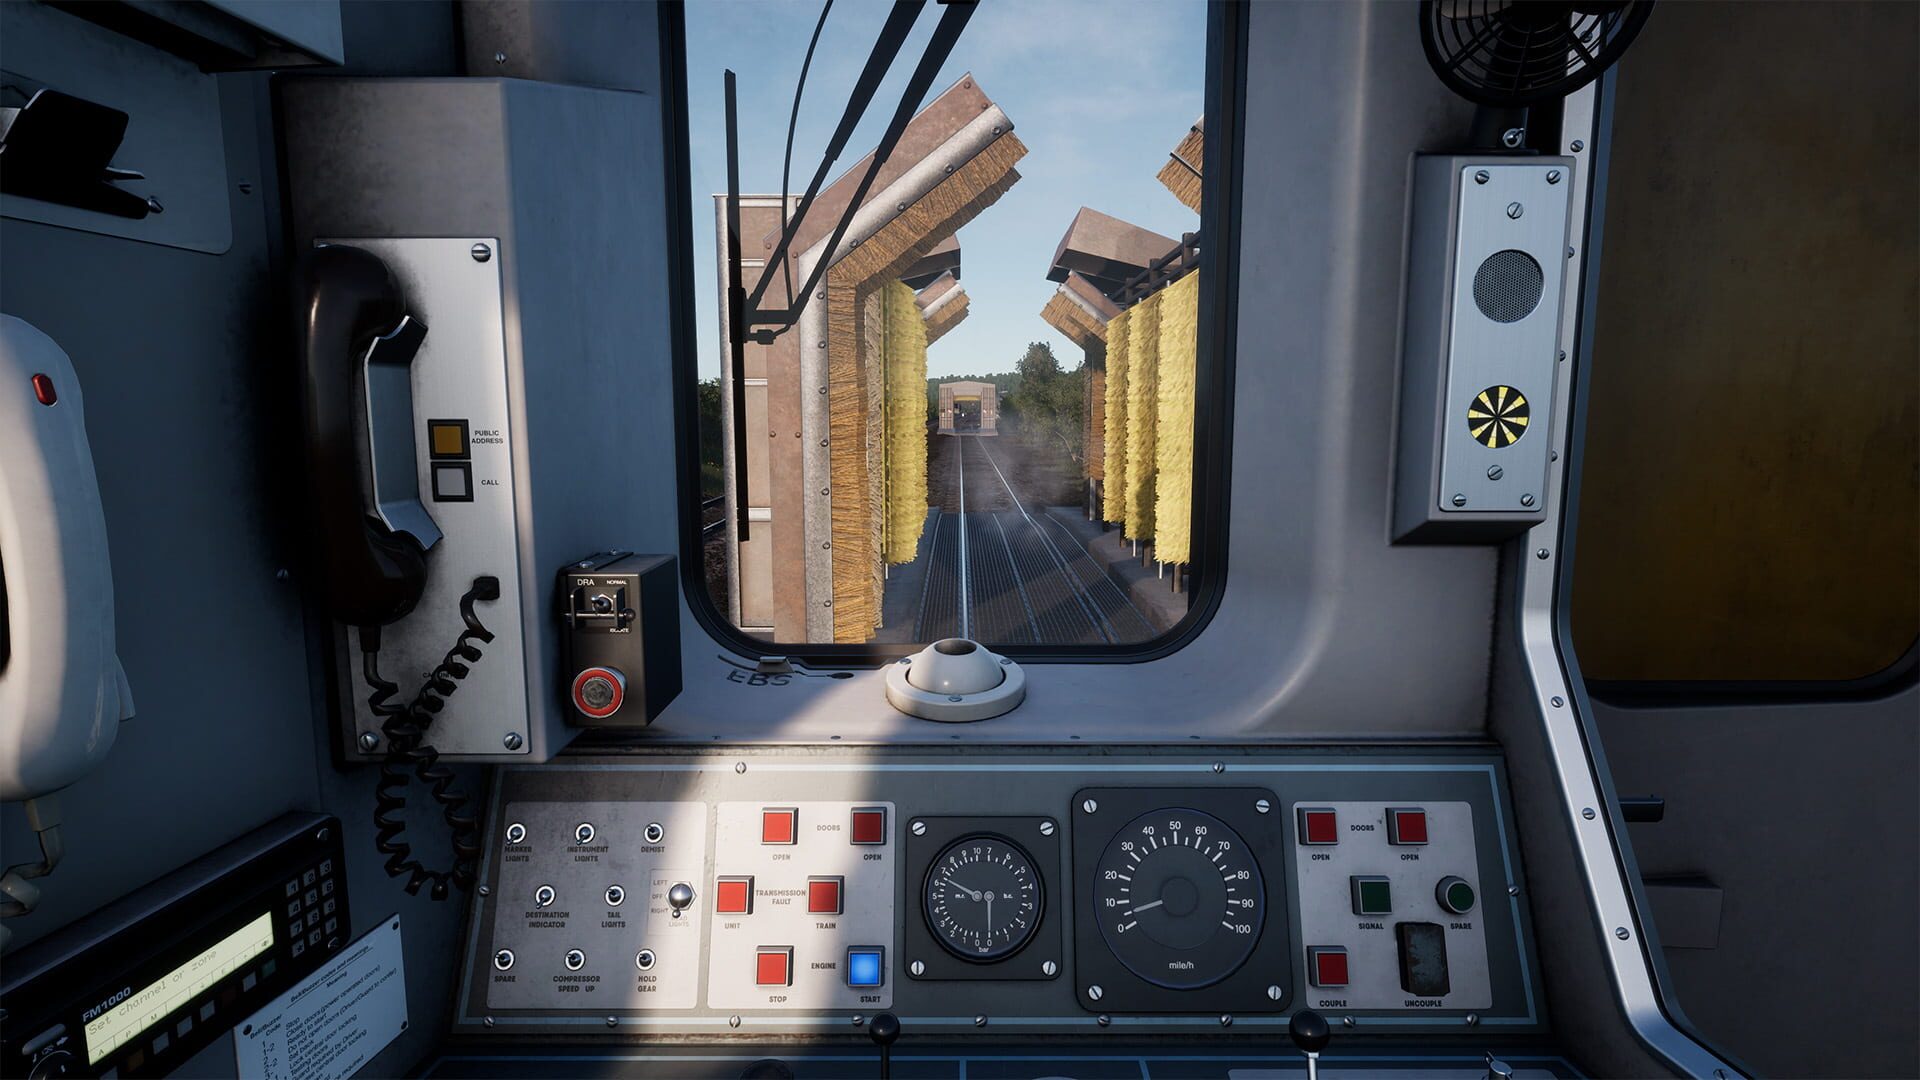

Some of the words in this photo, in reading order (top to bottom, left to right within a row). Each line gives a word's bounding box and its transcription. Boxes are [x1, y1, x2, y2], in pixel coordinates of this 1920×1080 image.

[726, 670, 793, 686] EBS
[1169, 821, 1181, 830] 50
[1142, 826, 1155, 835] 40
[1195, 826, 1207, 835] 60
[1121, 842, 1134, 851] 30
[1218, 841, 1230, 850] 70
[973, 847, 982, 855] 10
[949, 856, 955, 864] 8
[1105, 871, 1117, 880] 20
[1237, 871, 1250, 880] 80
[934, 879, 939, 887] 6
[1027, 902, 1033, 910] 3
[1106, 898, 1116, 907] 10
[1242, 899, 1254, 908] 90
[525, 911, 570, 919] DESTINATION
[607, 911, 621, 919] TAIL
[528, 921, 566, 929] INDICATOR
[601, 921, 626, 929] LIGHTS
[1020, 921, 1026, 929] 2
[1117, 924, 1124, 933] 0
[1235, 924, 1251, 934] 100
[811, 962, 837, 970] ENGINE
[1169, 961, 1194, 970] mile/h
[494, 975, 516, 983] SPARE
[553, 975, 601, 983] COMPRESSOR
[88, 1015, 112, 1035] Set
[119, 981, 166, 1016] channel
[172, 970, 185, 982] or
[191, 951, 217, 971] zone
[558, 985, 580, 993] SPEED
[585, 985, 595, 993] UP
[82, 986, 131, 1022] FM1000
[285, 1017, 300, 1032] Stop
[286, 1022, 303, 1038] Close
[304, 1010, 321, 1025] doors
[266, 1023, 281, 1036] Code
[287, 1028, 306, 1046] Ready
[314, 1013, 327, 1026] start
[309, 1024, 324, 1038] open
[289, 1055, 303, 1071] Lock
[304, 1039, 324, 1057] central
[324, 1029, 337, 1042] door
[338, 1014, 357, 1031] locking
[299, 1039, 314, 1053] back
[335, 1042, 349, 1057] door
[349, 1029, 367, 1047] locking
[310, 1047, 334, 1070] required
[343, 1028, 358, 1043] Driver
[290, 1058, 311, 1077] Testing
[312, 1044, 328, 1060] doors
